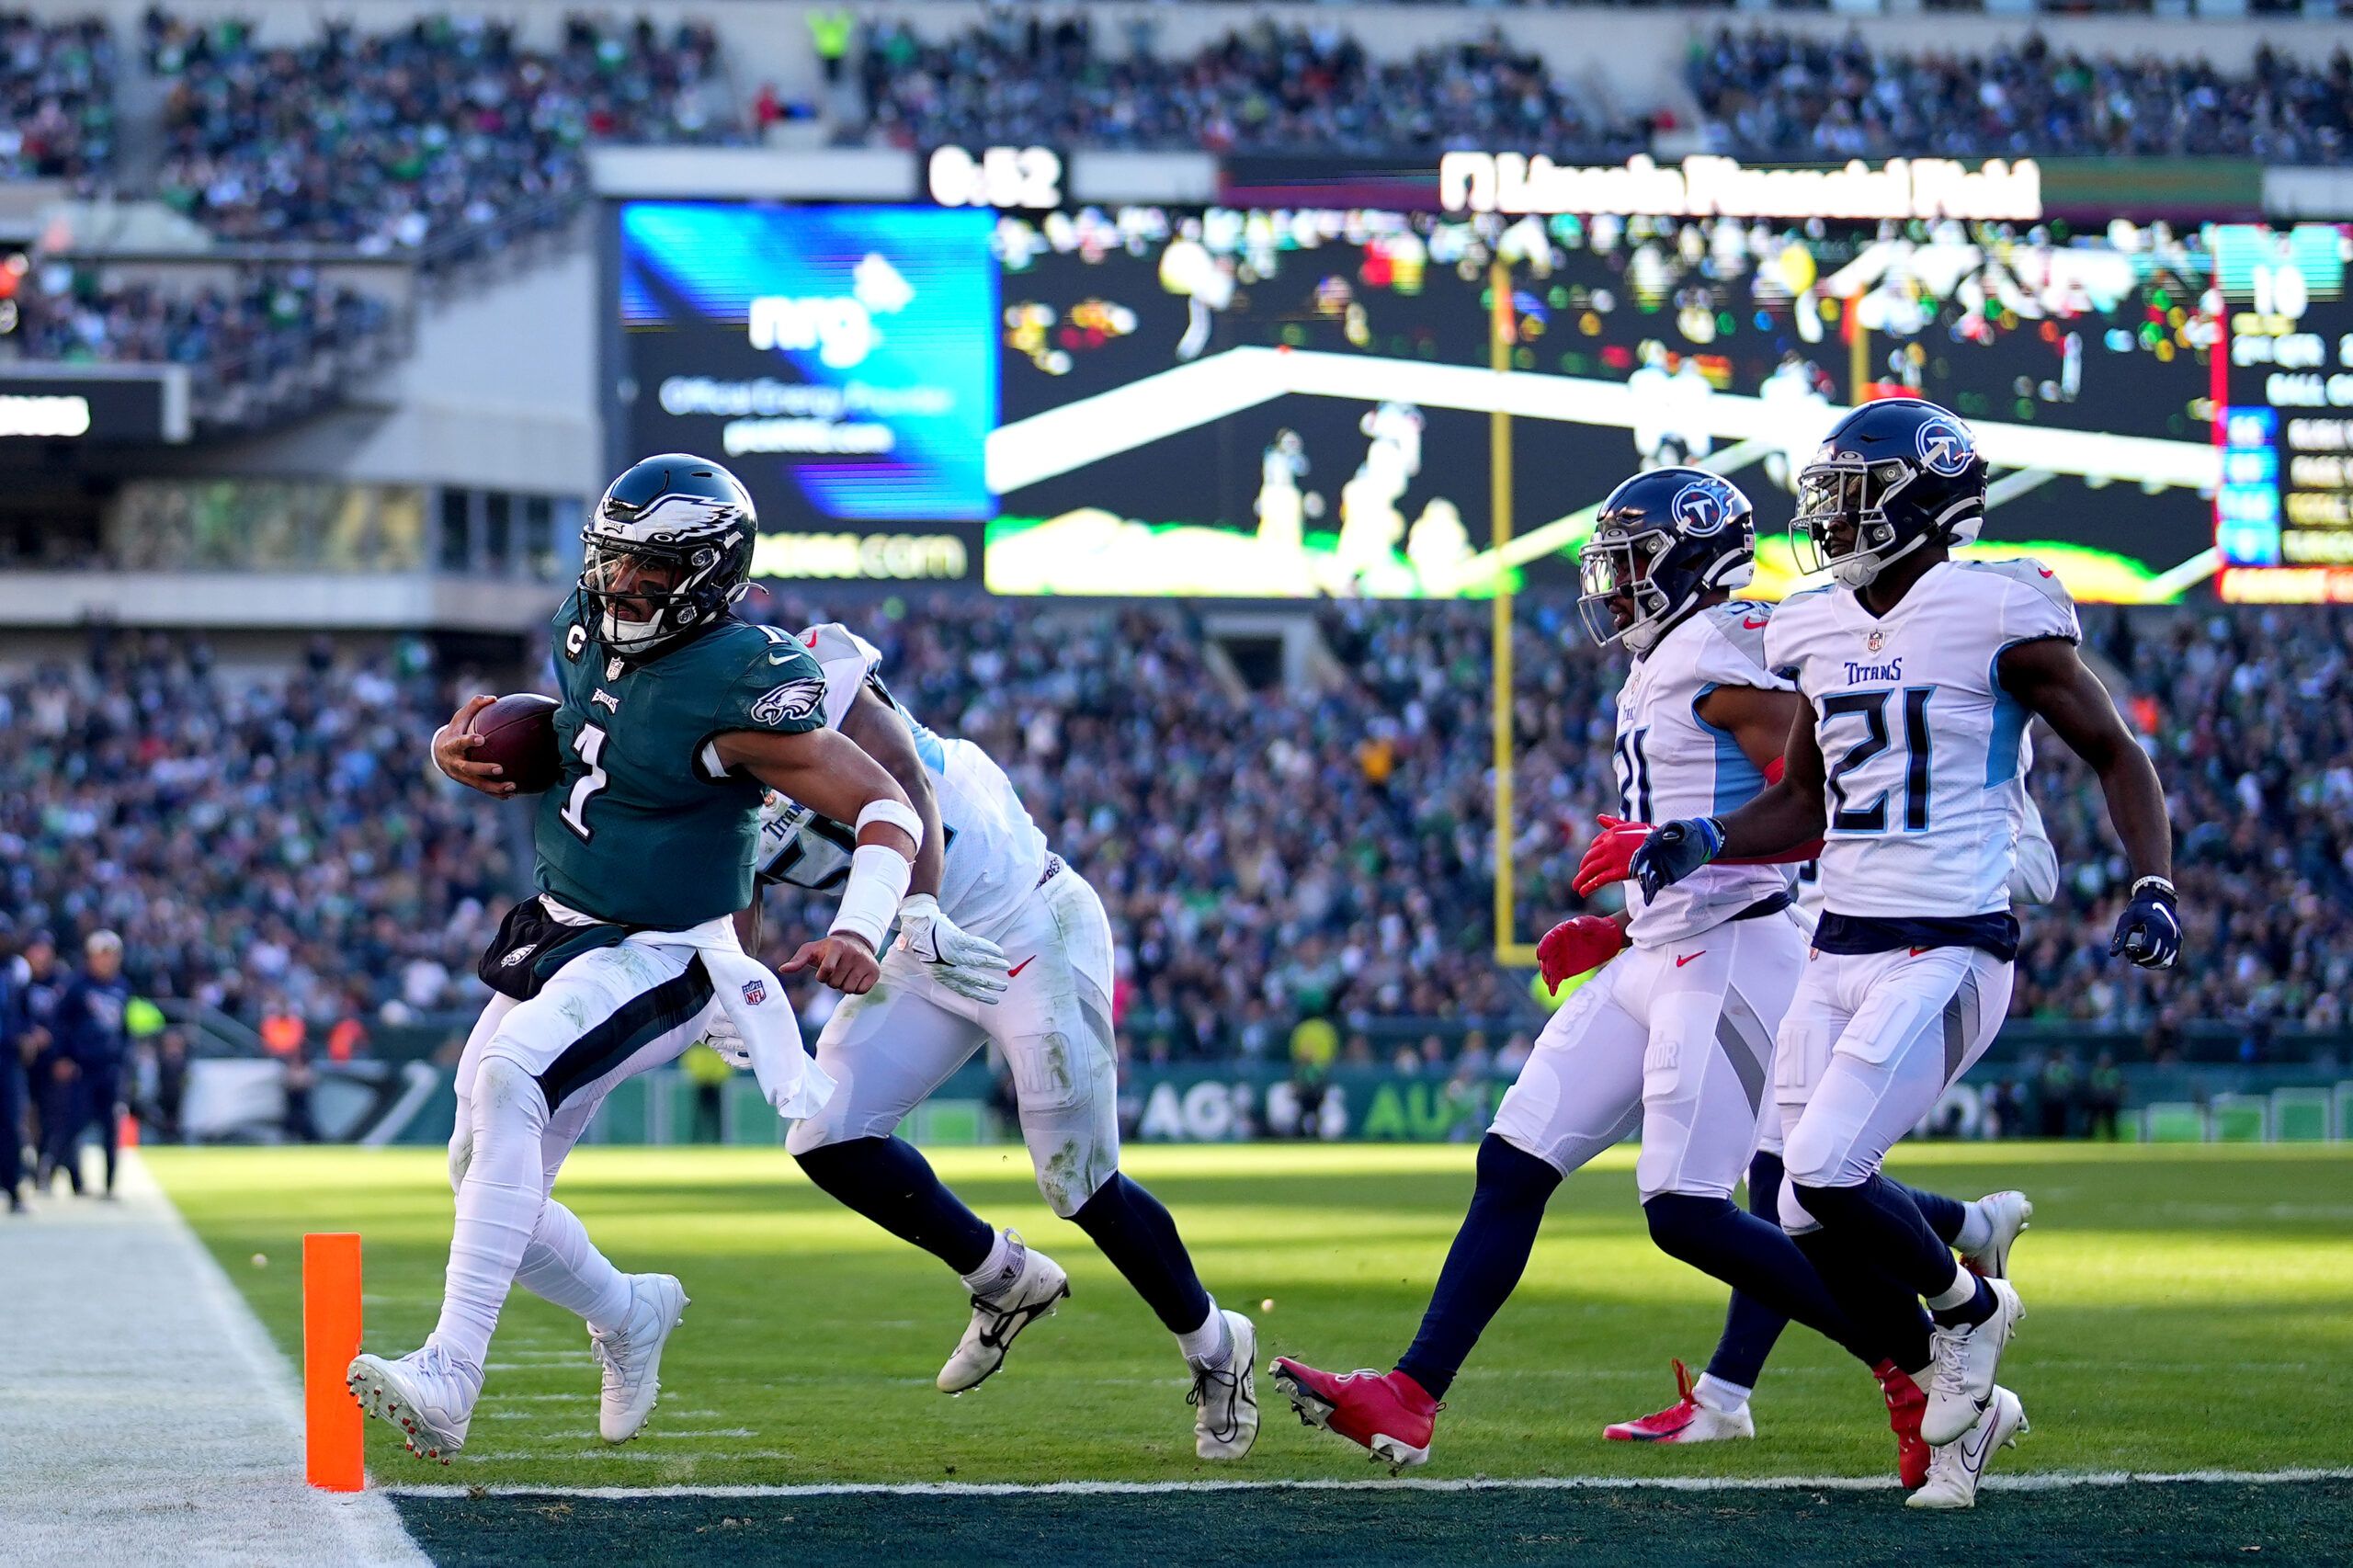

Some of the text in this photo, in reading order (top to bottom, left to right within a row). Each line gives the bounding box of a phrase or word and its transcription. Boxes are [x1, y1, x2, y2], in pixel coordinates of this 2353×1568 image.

[566, 624, 587, 654] C
[1821, 687, 1938, 834] 21
[560, 722, 608, 838] 1
[761, 800, 807, 842] TITAN
[745, 989, 766, 1004] NFL
[1643, 1040, 1678, 1074] YOR
